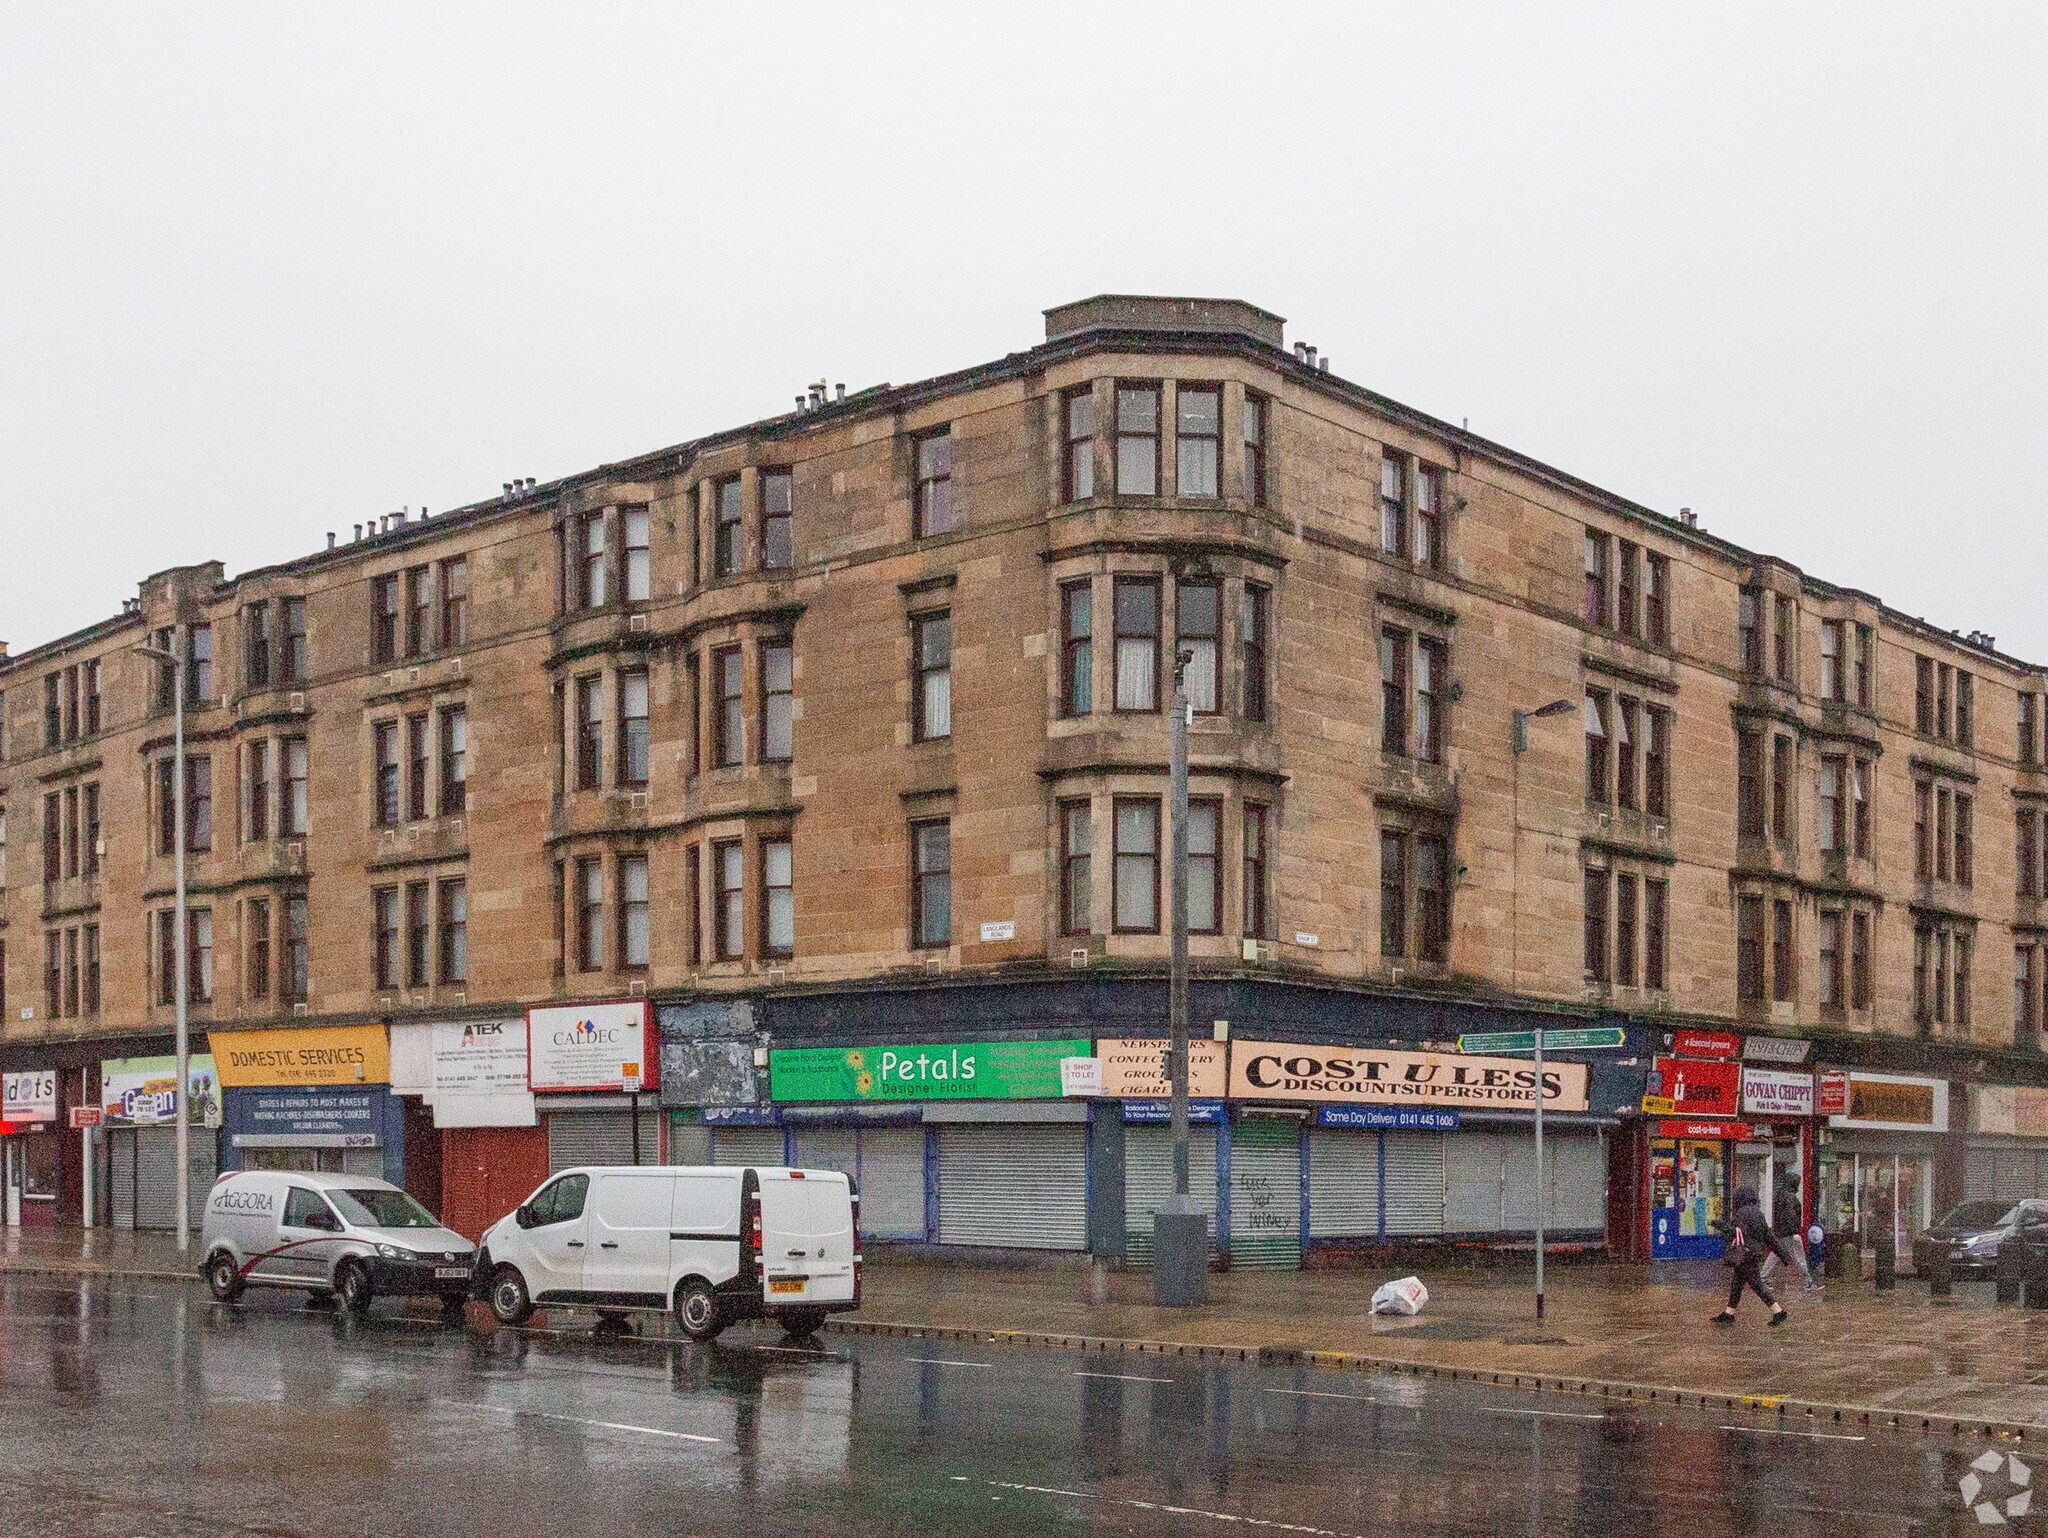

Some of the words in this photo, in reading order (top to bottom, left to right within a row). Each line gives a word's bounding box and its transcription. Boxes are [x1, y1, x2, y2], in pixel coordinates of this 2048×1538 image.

[553, 1029, 620, 1046] CALDEC
[1120, 1041, 1206, 1049] NEWSPARS
[230, 1050, 296, 1067] DOMESTIC
[298, 1047, 365, 1065] SERVICES
[882, 1049, 975, 1081] Petals
[1246, 1055, 1389, 1088] COST
[1404, 1063, 1441, 1083] U
[1452, 1066, 1562, 1100] LESS
[882, 1083, 934, 1096] Designer
[940, 1083, 977, 1094] Florist
[1746, 1081, 1778, 1099] GOVAN
[1778, 1084, 1812, 1101] CHIPPY
[1192, 1105, 1220, 1113] Designed
[1326, 1111, 1349, 1123] Same
[1350, 1112, 1365, 1125] Day
[1367, 1113, 1397, 1126] Delivery
[1400, 1113, 1418, 1125] 0141
[1420, 1115, 1434, 1126] 445
[1436, 1115, 1453, 1127] 1606
[214, 1188, 273, 1211] AGGORA
